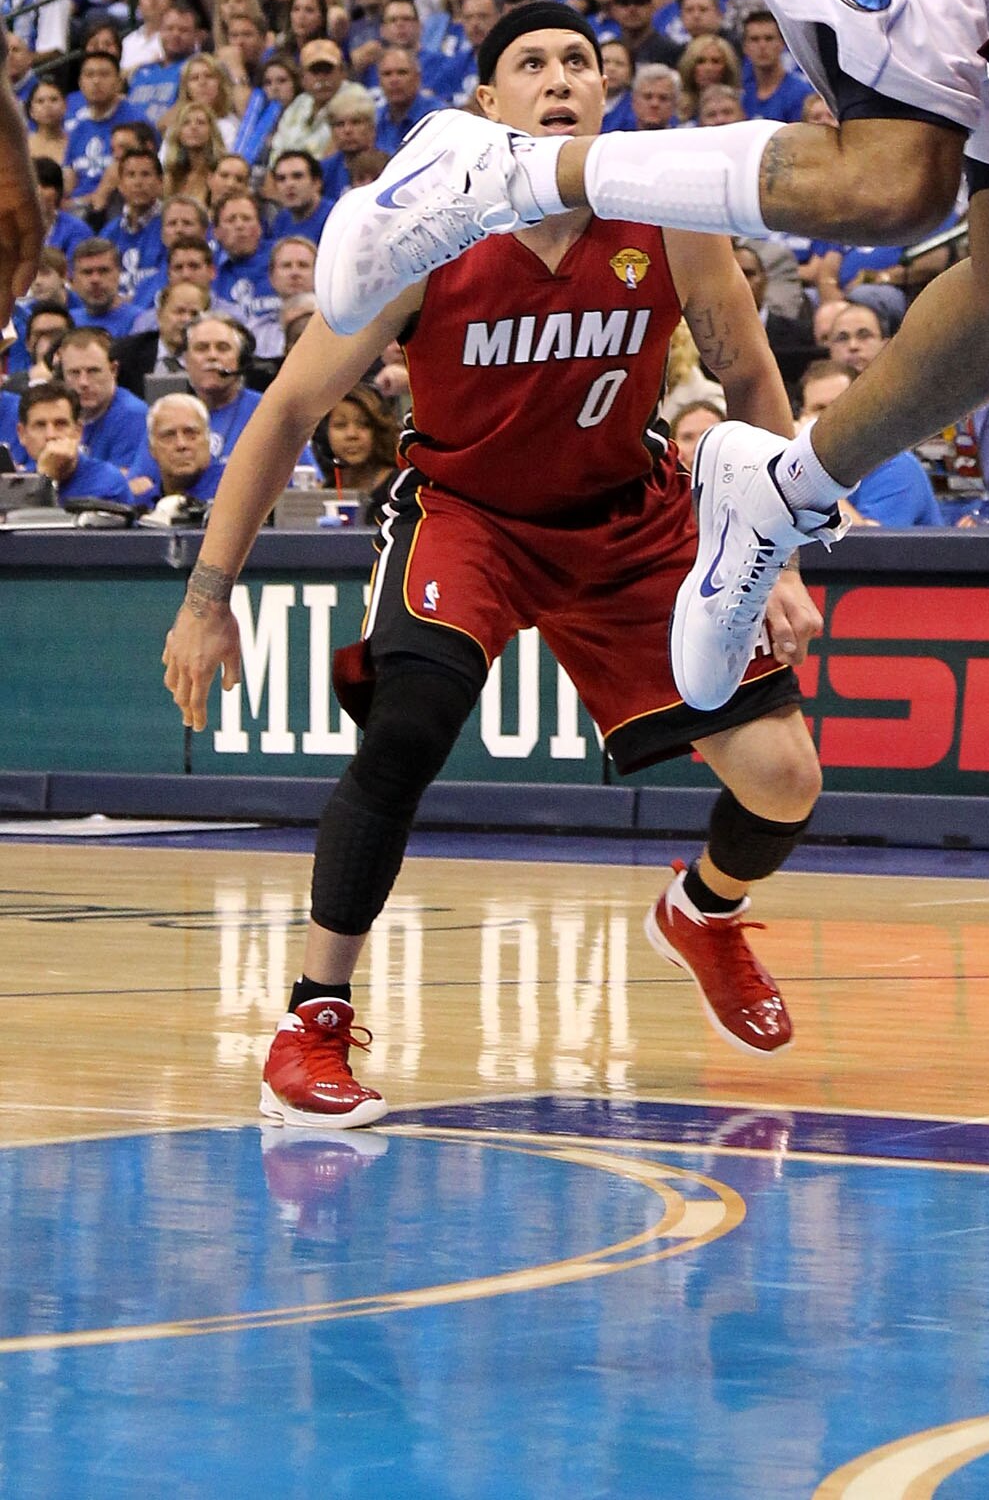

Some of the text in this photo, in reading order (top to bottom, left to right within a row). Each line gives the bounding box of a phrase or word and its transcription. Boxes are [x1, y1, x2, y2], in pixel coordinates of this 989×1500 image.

[462, 309, 652, 366] MIAMI
[576, 369, 628, 428] 0
[214, 584, 371, 755] ML
